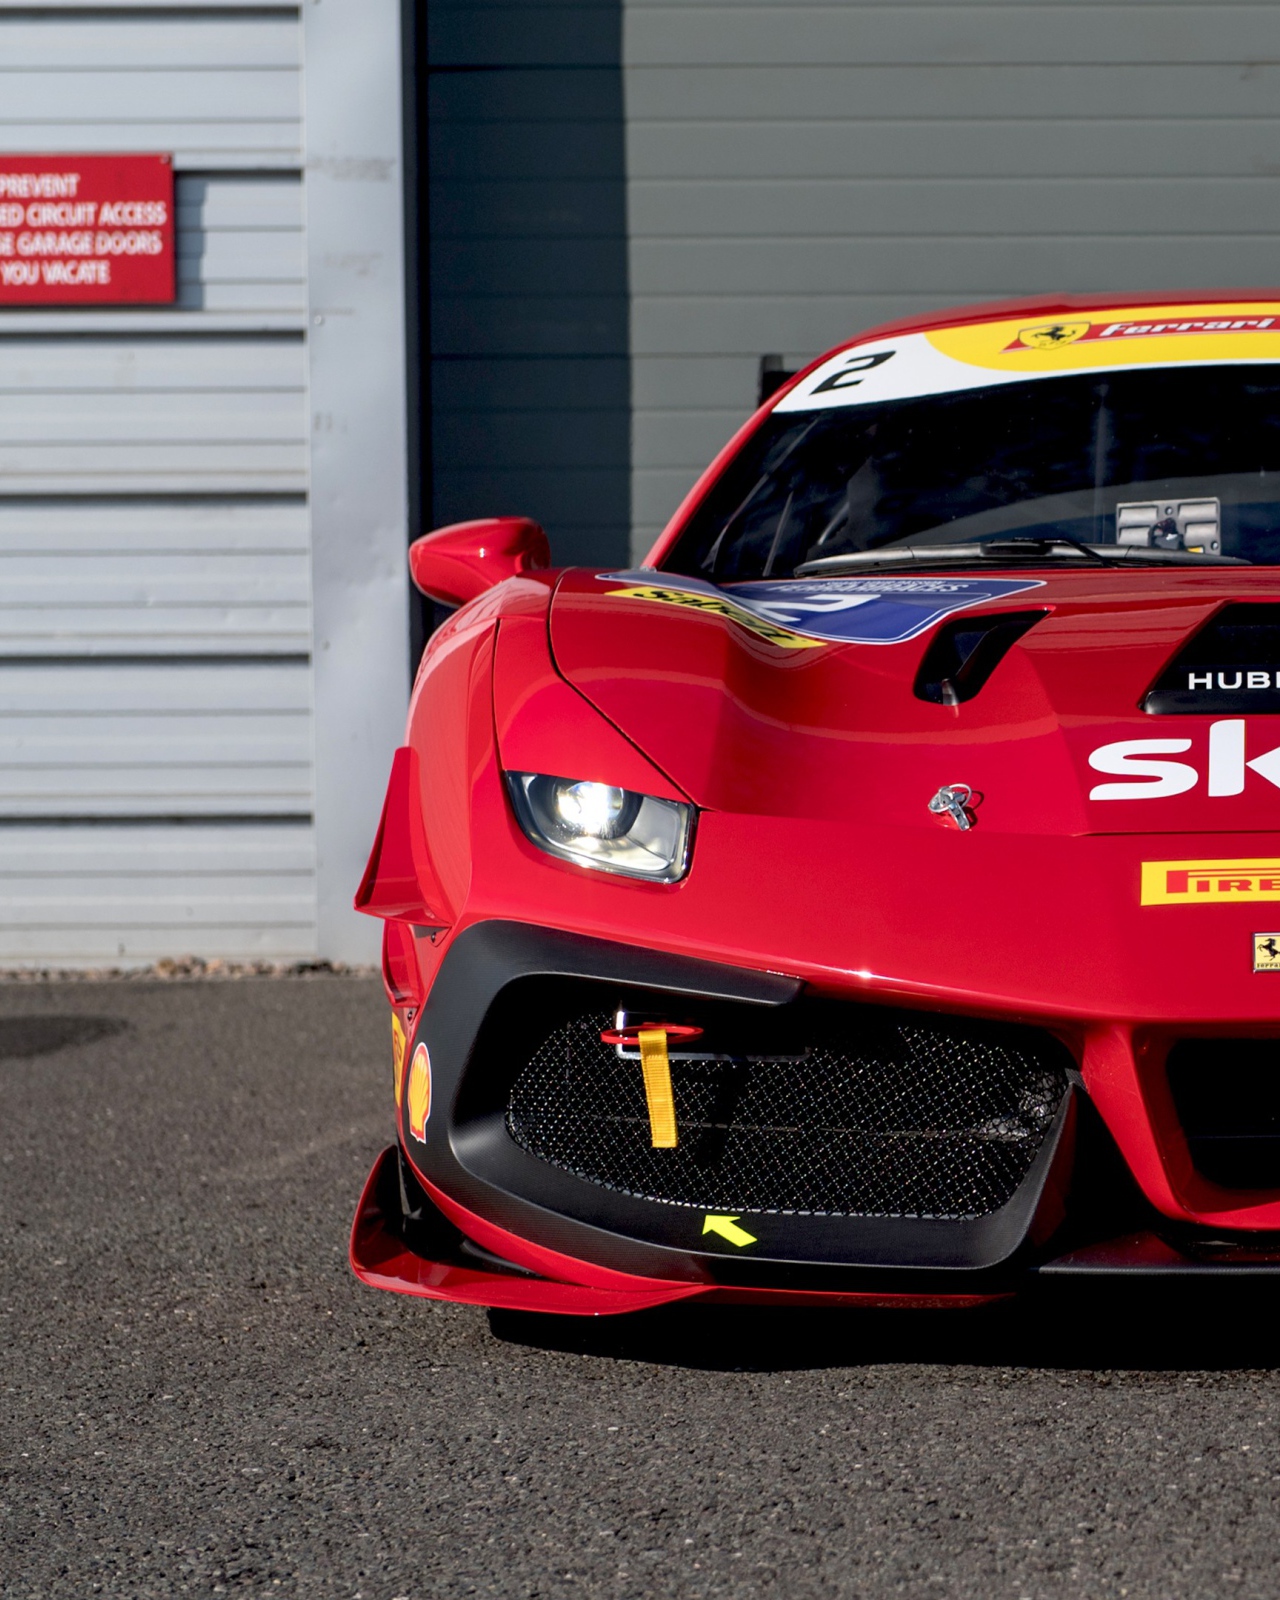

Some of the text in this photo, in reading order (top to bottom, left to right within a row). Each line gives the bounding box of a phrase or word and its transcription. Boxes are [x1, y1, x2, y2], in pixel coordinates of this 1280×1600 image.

[0, 173, 80, 198] PREVENT
[26, 202, 97, 228] CIRCUIT
[98, 201, 167, 226] ACCESS
[17, 231, 94, 256] GARAGE
[95, 230, 162, 256] DOORS
[0, 260, 110, 286] YOU VACATE
[1099, 317, 1275, 337] Ferrari
[809, 350, 897, 396] 2
